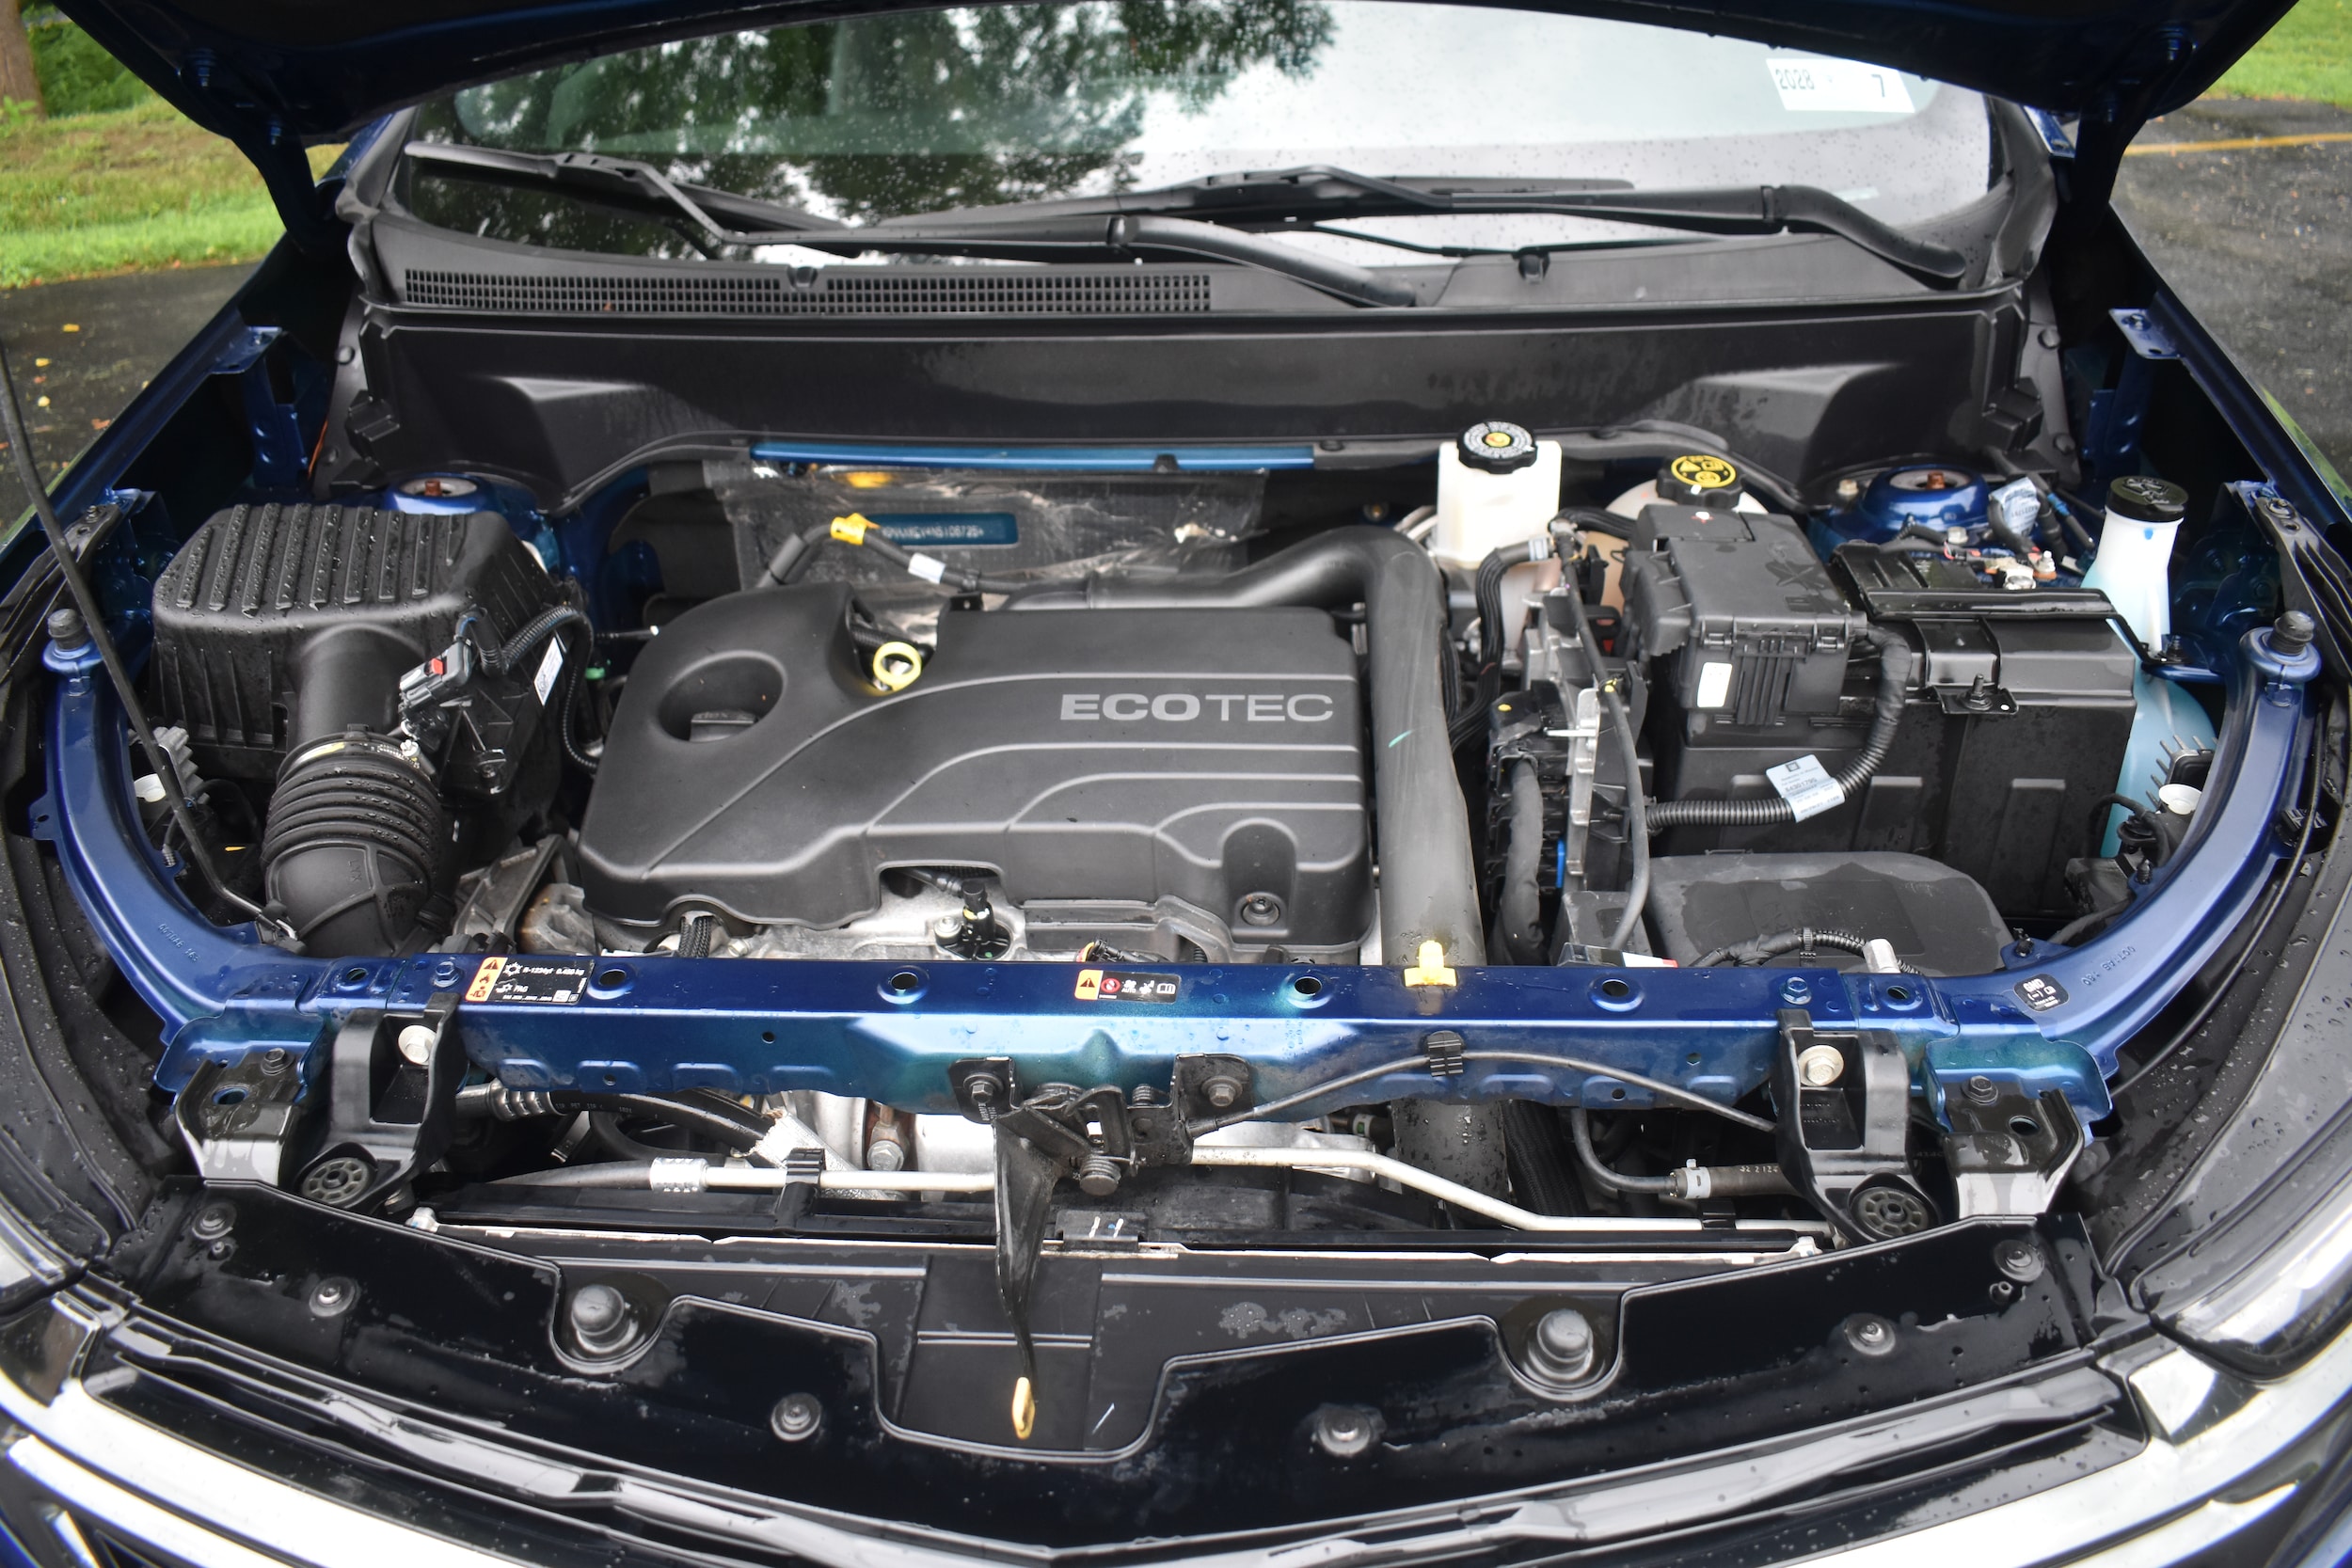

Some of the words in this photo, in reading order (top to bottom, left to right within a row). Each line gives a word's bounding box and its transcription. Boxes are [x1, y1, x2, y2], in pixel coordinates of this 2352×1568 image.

[1871, 73, 1886, 98] 7
[1060, 693, 1333, 721] ECOTEC
[2023, 978, 2045, 993] GND
